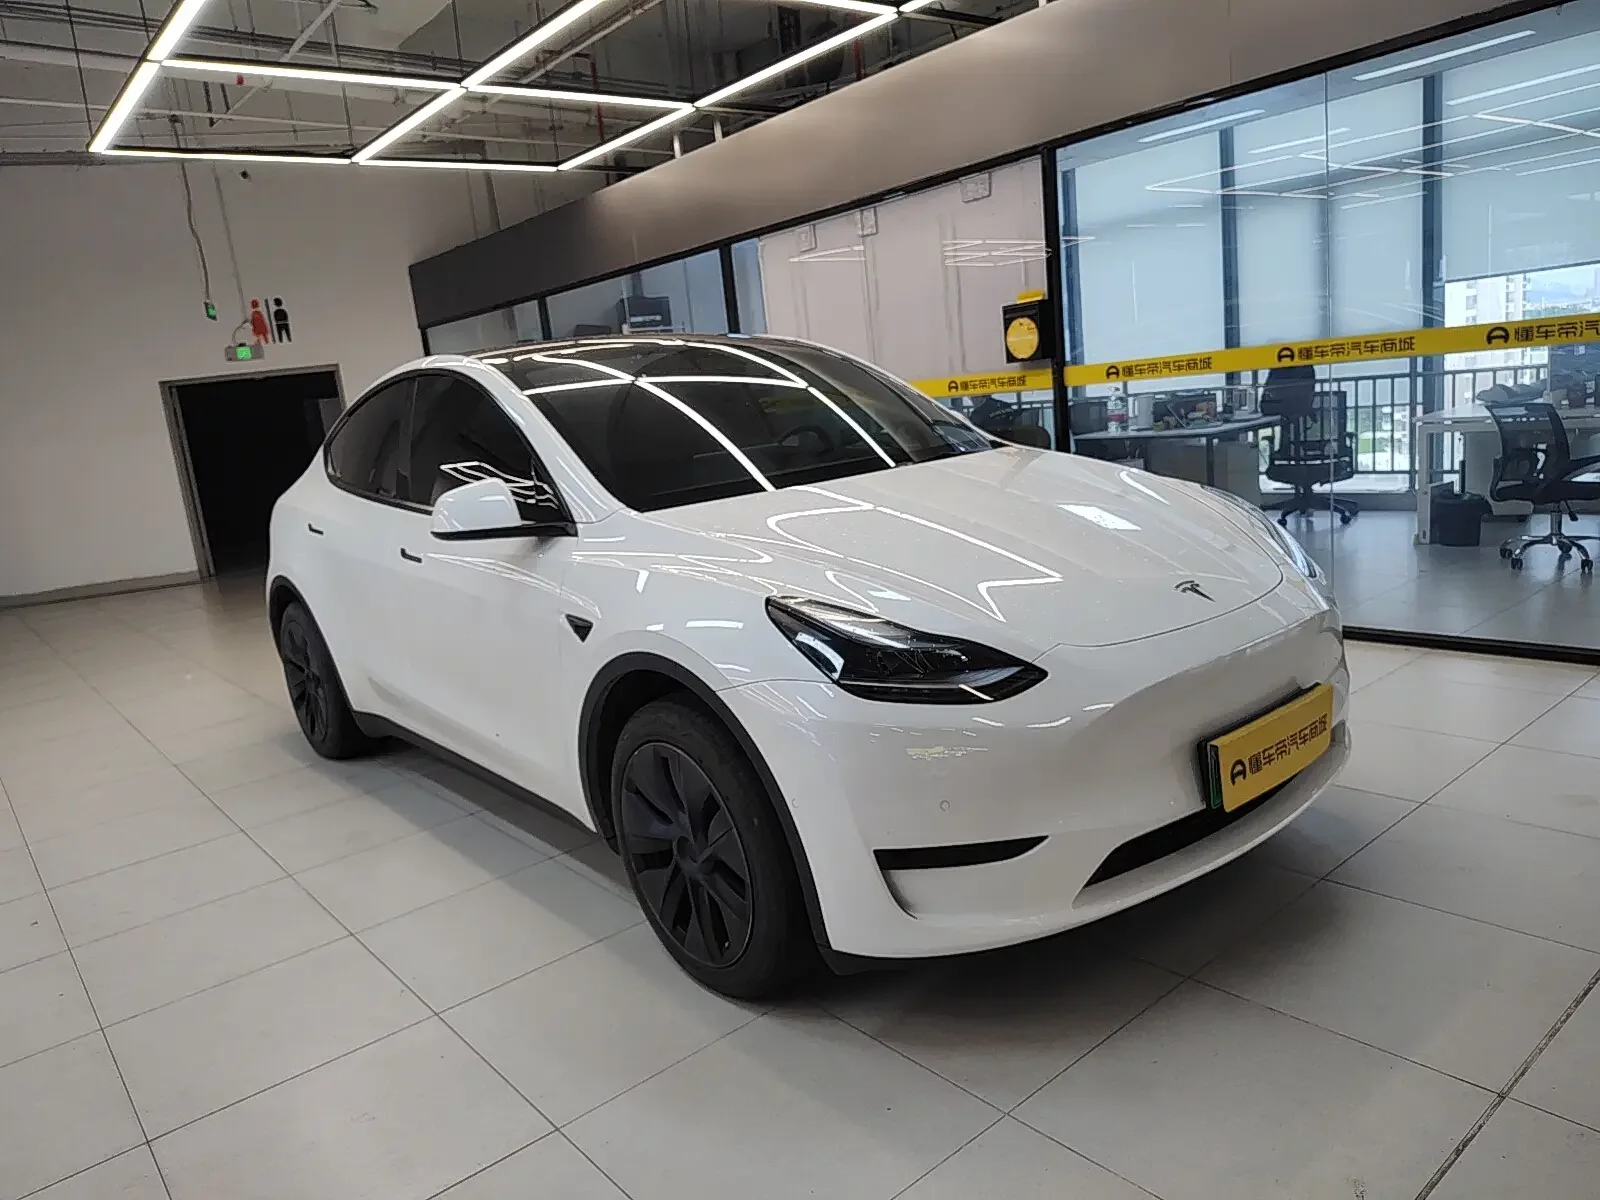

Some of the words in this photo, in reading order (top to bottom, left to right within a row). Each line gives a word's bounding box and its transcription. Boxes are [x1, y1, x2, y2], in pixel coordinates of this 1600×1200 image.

[1514, 320, 1600, 342] 懂车帝汽
[1298, 336, 1415, 360] 懂车帝汽车商城
[1122, 357, 1212, 377] 懂车帝汽车商城
[1248, 713, 1327, 775] 懂车帝汽车商城
